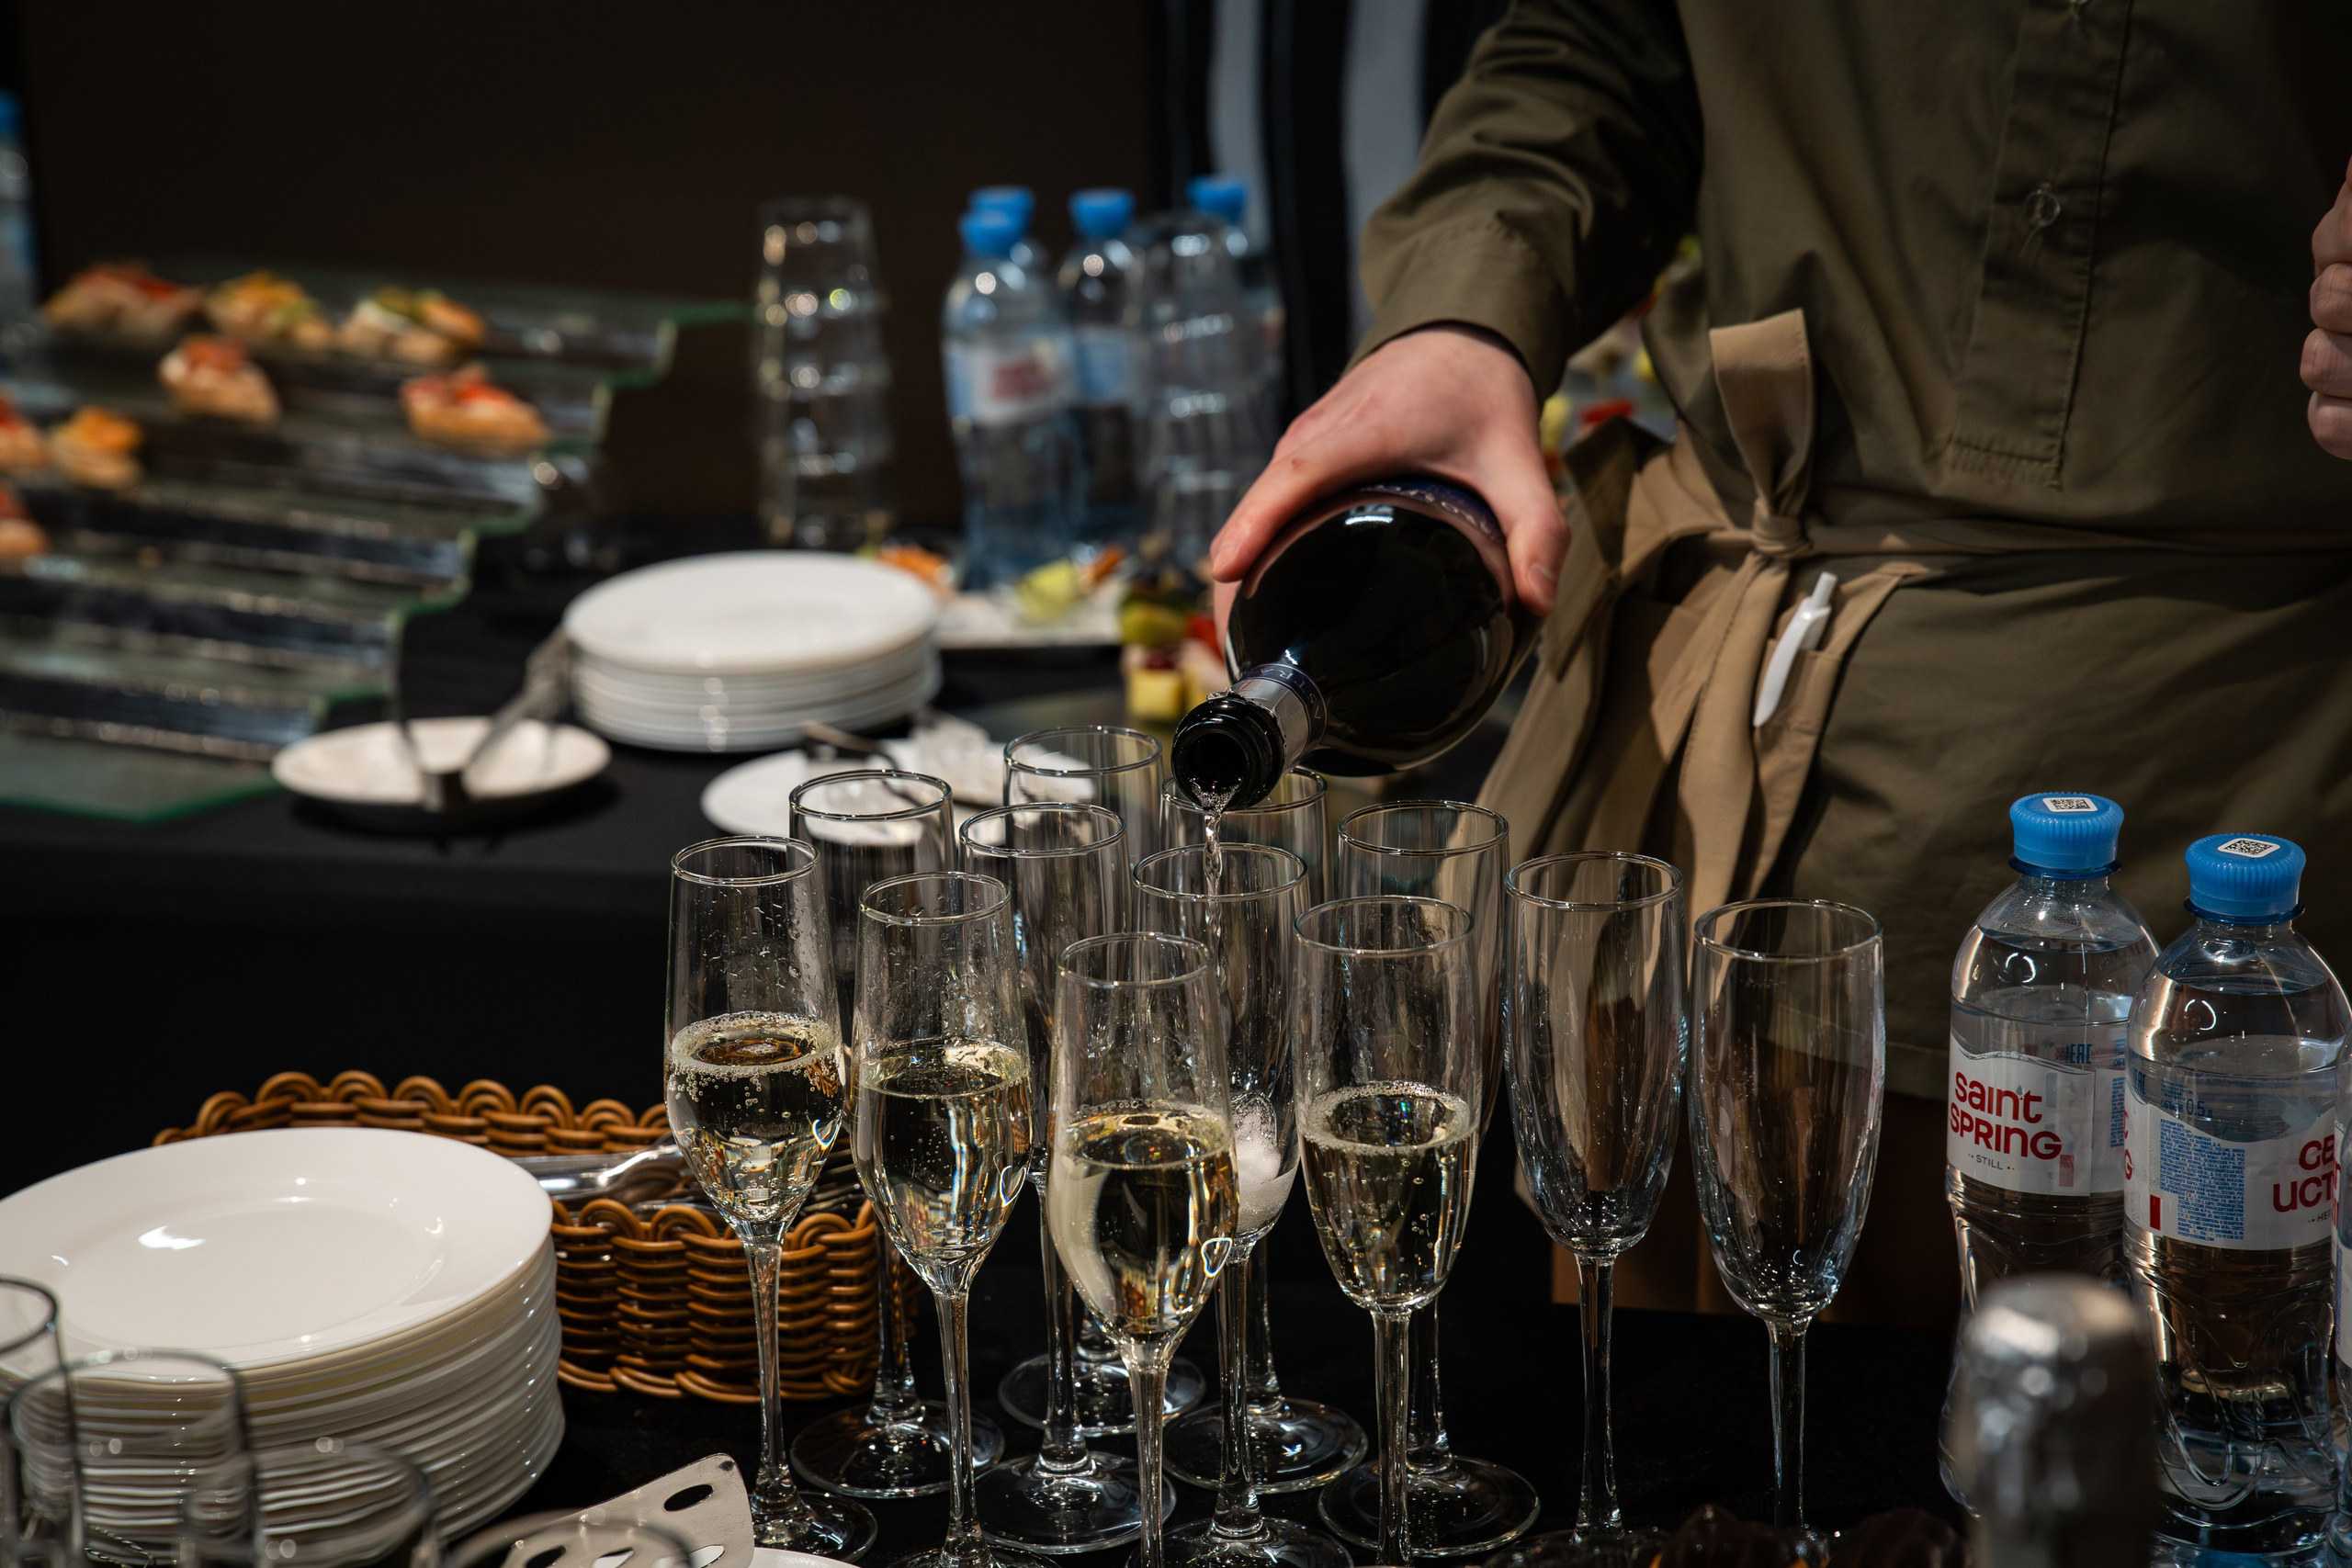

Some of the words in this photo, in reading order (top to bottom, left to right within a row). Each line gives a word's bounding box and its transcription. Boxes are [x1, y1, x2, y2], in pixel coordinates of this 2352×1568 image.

[1950, 1101, 2063, 1160] SPRING
[1975, 1154, 2004, 1171] STILL
[2317, 1209, 2332, 1223] НЕГ
